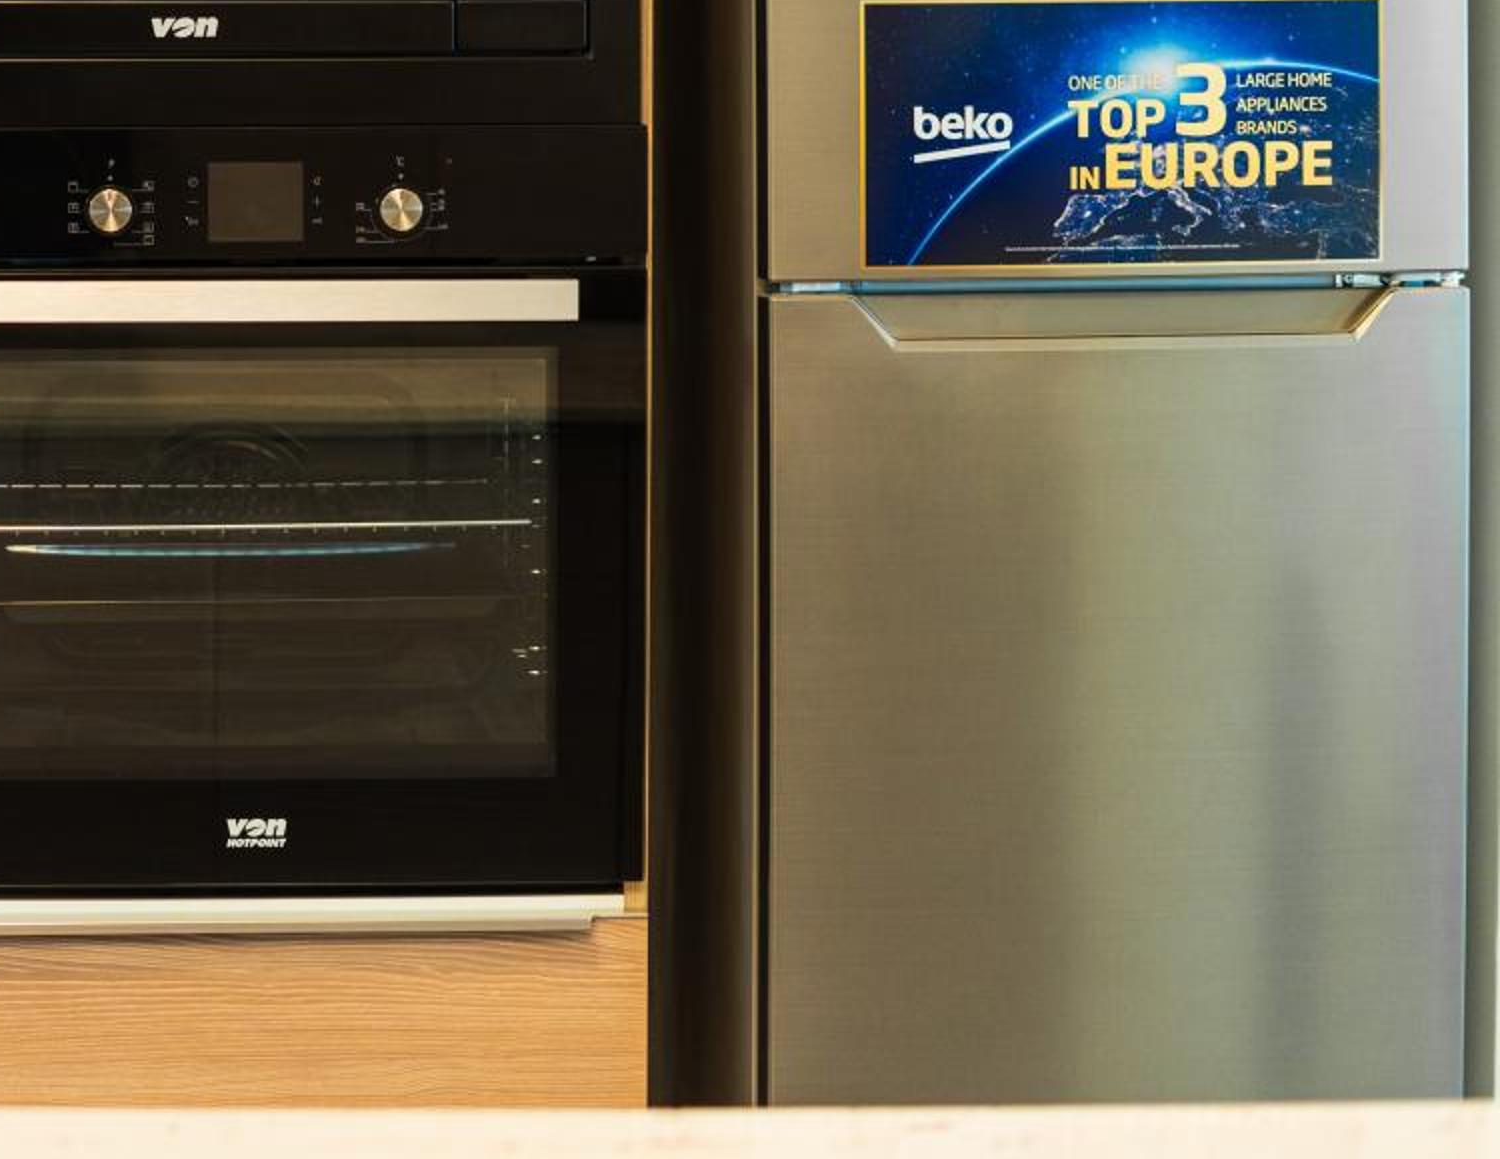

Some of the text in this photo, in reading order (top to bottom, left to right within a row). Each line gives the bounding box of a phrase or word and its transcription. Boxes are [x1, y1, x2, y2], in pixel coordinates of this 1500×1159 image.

[151, 17, 219, 38] von
[1068, 74, 1101, 91] ONE
[1104, 74, 1125, 91] OF
[1236, 72, 1332, 88] LARGE HOME
[1068, 62, 1227, 138] TOP 3
[1235, 97, 1328, 112] APPLIANCES
[913, 105, 1013, 140] beko
[1236, 120, 1298, 135] BRANDS
[1069, 140, 1333, 190] IN EUROPE
[226, 818, 287, 837] von
[226, 838, 287, 848] HOTPOINT
